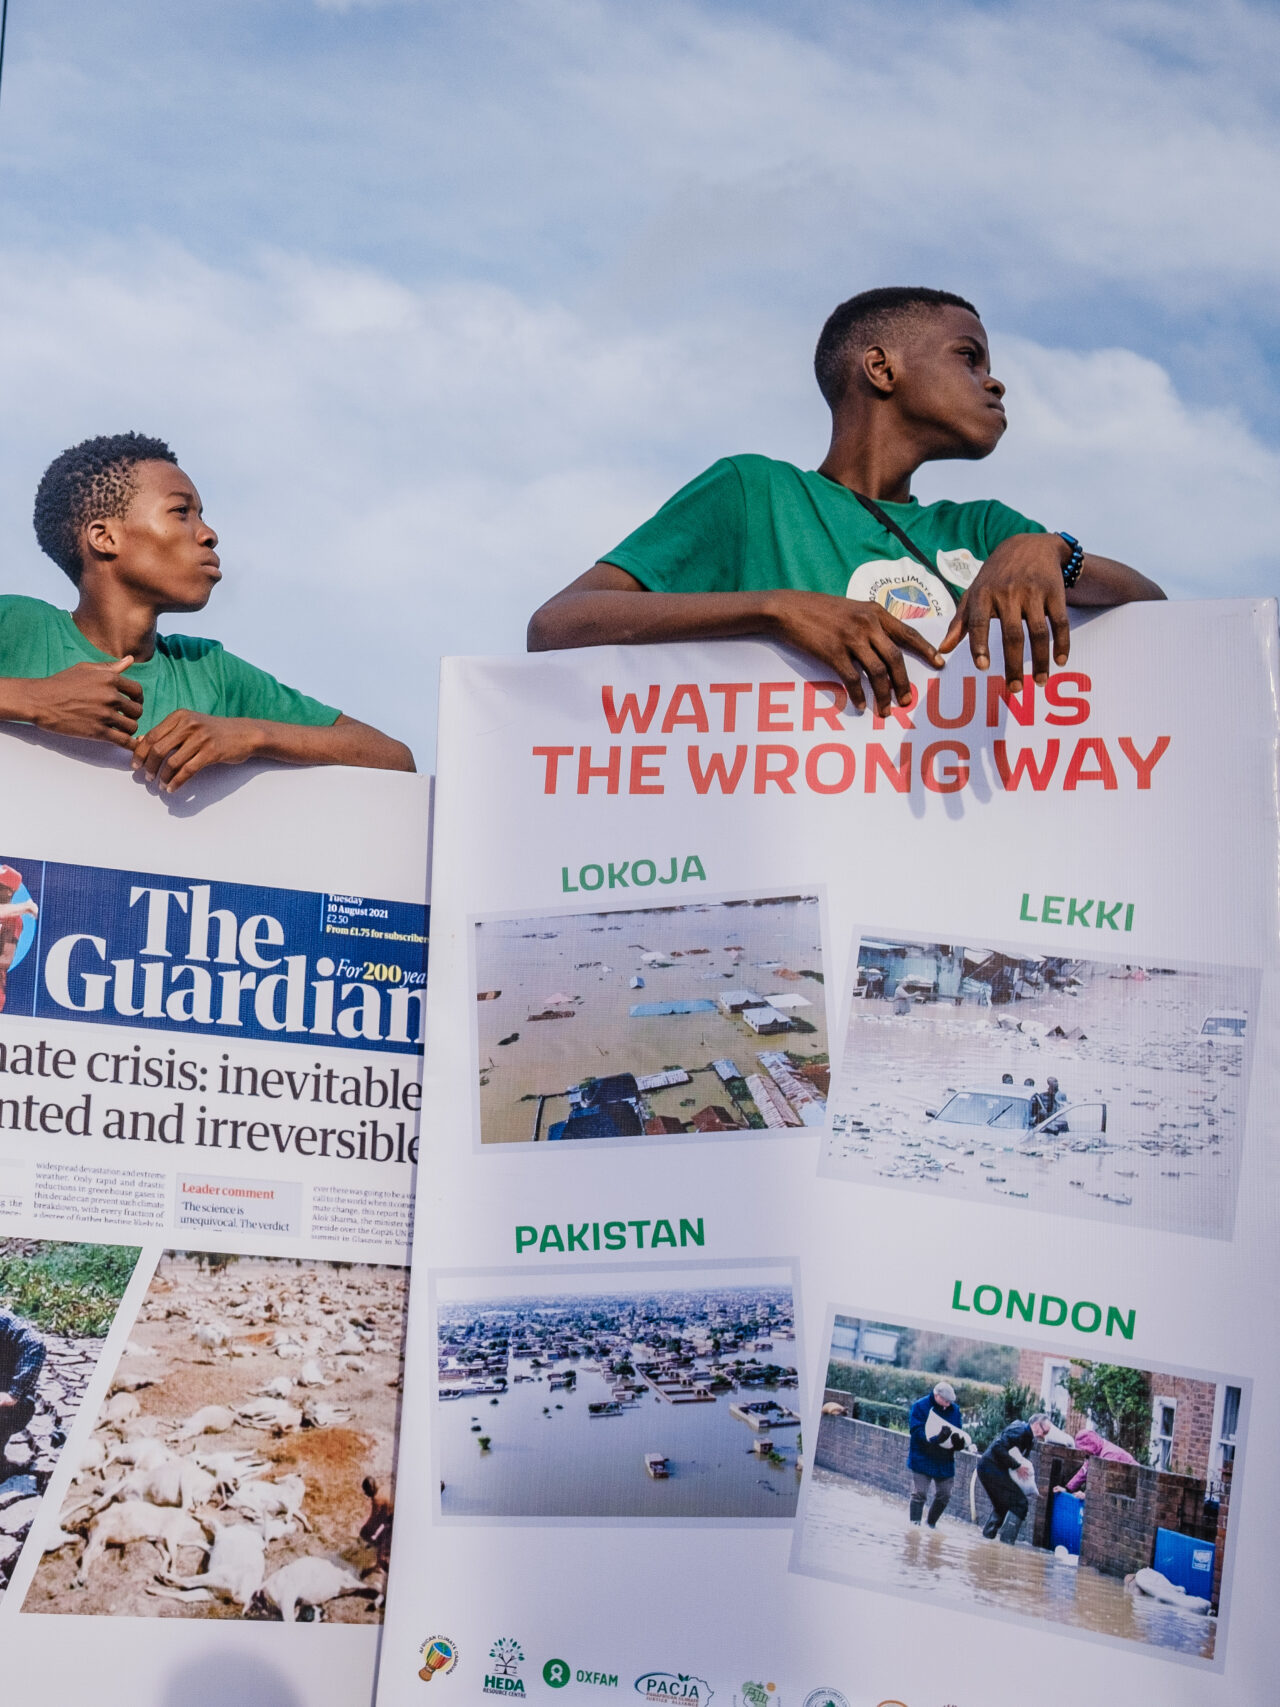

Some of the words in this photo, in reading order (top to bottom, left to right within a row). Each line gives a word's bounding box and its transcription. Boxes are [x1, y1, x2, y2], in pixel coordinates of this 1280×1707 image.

[894, 576, 933, 597] CLIMATE
[600, 681, 846, 734] WATER
[871, 672, 1092, 730] RUNS
[532, 744, 668, 796] THE
[686, 740, 971, 796] WRONG
[994, 735, 1172, 792] WAY
[560, 854, 707, 893] LOKOJA
[327, 904, 338, 912] 10
[338, 905, 368, 916] August
[369, 908, 389, 919] 2021
[328, 894, 364, 906] Tuesday
[1018, 892, 1135, 932] LEKKI
[128, 884, 285, 969] The
[326, 924, 349, 935] From
[371, 929, 384, 938] for
[336, 958, 363, 979] For
[363, 961, 402, 983] 200
[44, 933, 427, 1044] Guardian
[87, 1044, 208, 1093] crisis:
[217, 1053, 422, 1112] inevitable
[102, 1102, 184, 1145] and
[182, 1182, 220, 1195] Leader
[222, 1188, 275, 1200] comment
[202, 1203, 236, 1214] science
[237, 1206, 245, 1215] is
[240, 1218, 257, 1229] The
[258, 1221, 289, 1232] verdict
[514, 1217, 706, 1254] PAKISTAN
[951, 1279, 1137, 1342] LONDON
[484, 1674, 525, 1692] HEDA
[576, 1669, 618, 1688] OXFAM
[646, 1679, 699, 1698] PACJA
[483, 1688, 507, 1696] RESOURCE
